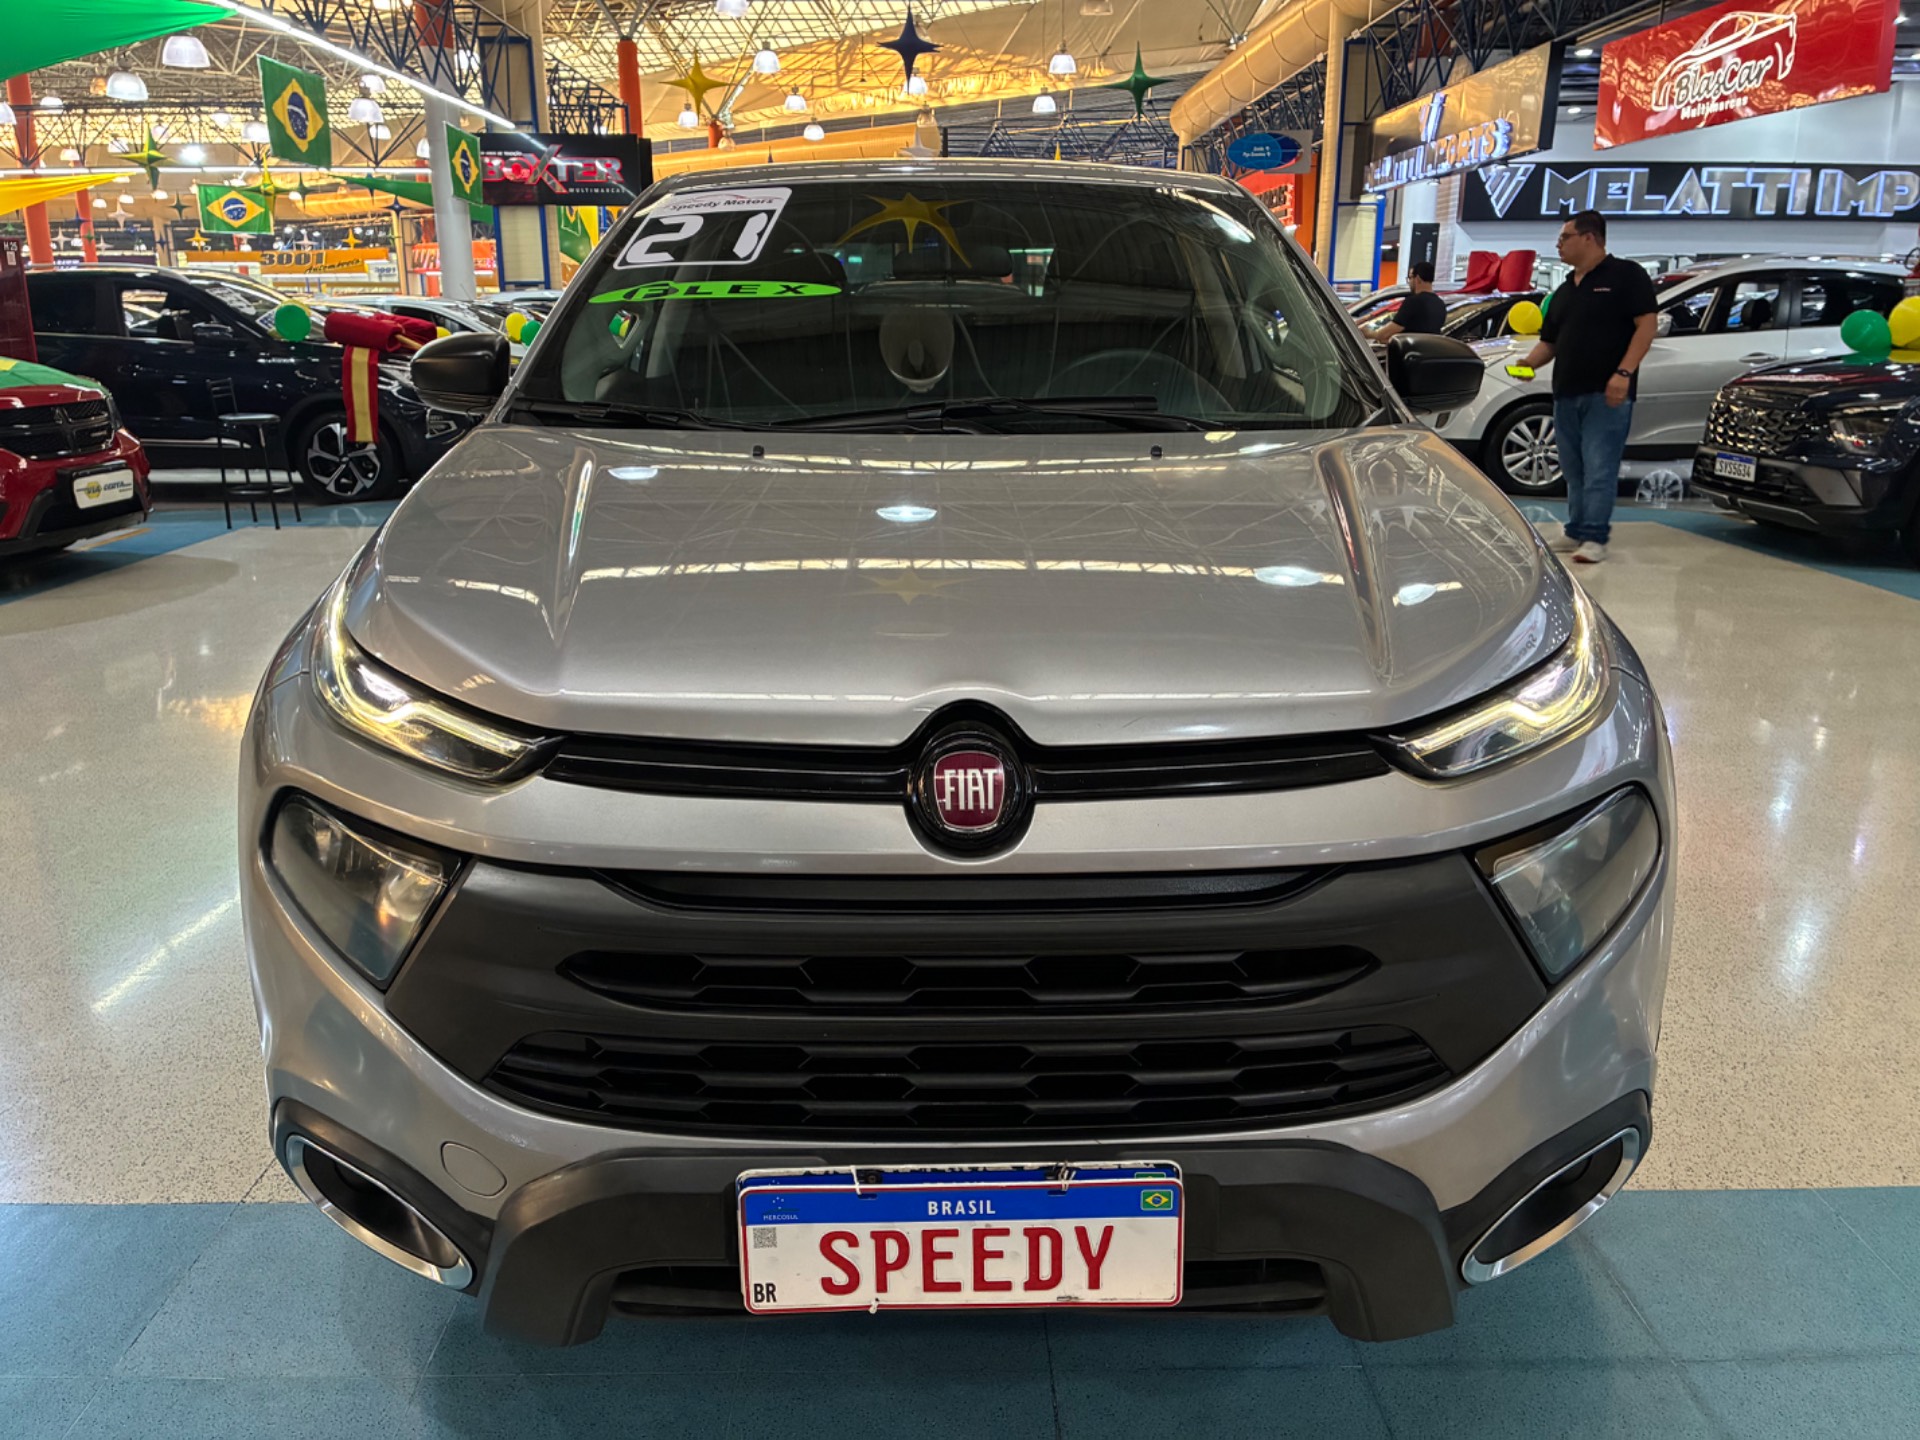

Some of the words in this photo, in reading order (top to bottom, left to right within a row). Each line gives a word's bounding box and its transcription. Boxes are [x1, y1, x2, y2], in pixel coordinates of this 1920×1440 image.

[481, 144, 625, 194] BOXTER
[671, 201, 721, 211] Speedy
[1540, 167, 1812, 215] MELATTI
[625, 212, 769, 264] 21
[259, 251, 326, 267] 3001
[622, 281, 808, 300] FLEX
[944, 768, 998, 811] FIAT
[927, 1199, 996, 1216] BRASIL
[819, 1225, 1114, 1296] SPEEDY
[753, 1282, 777, 1303] BR
